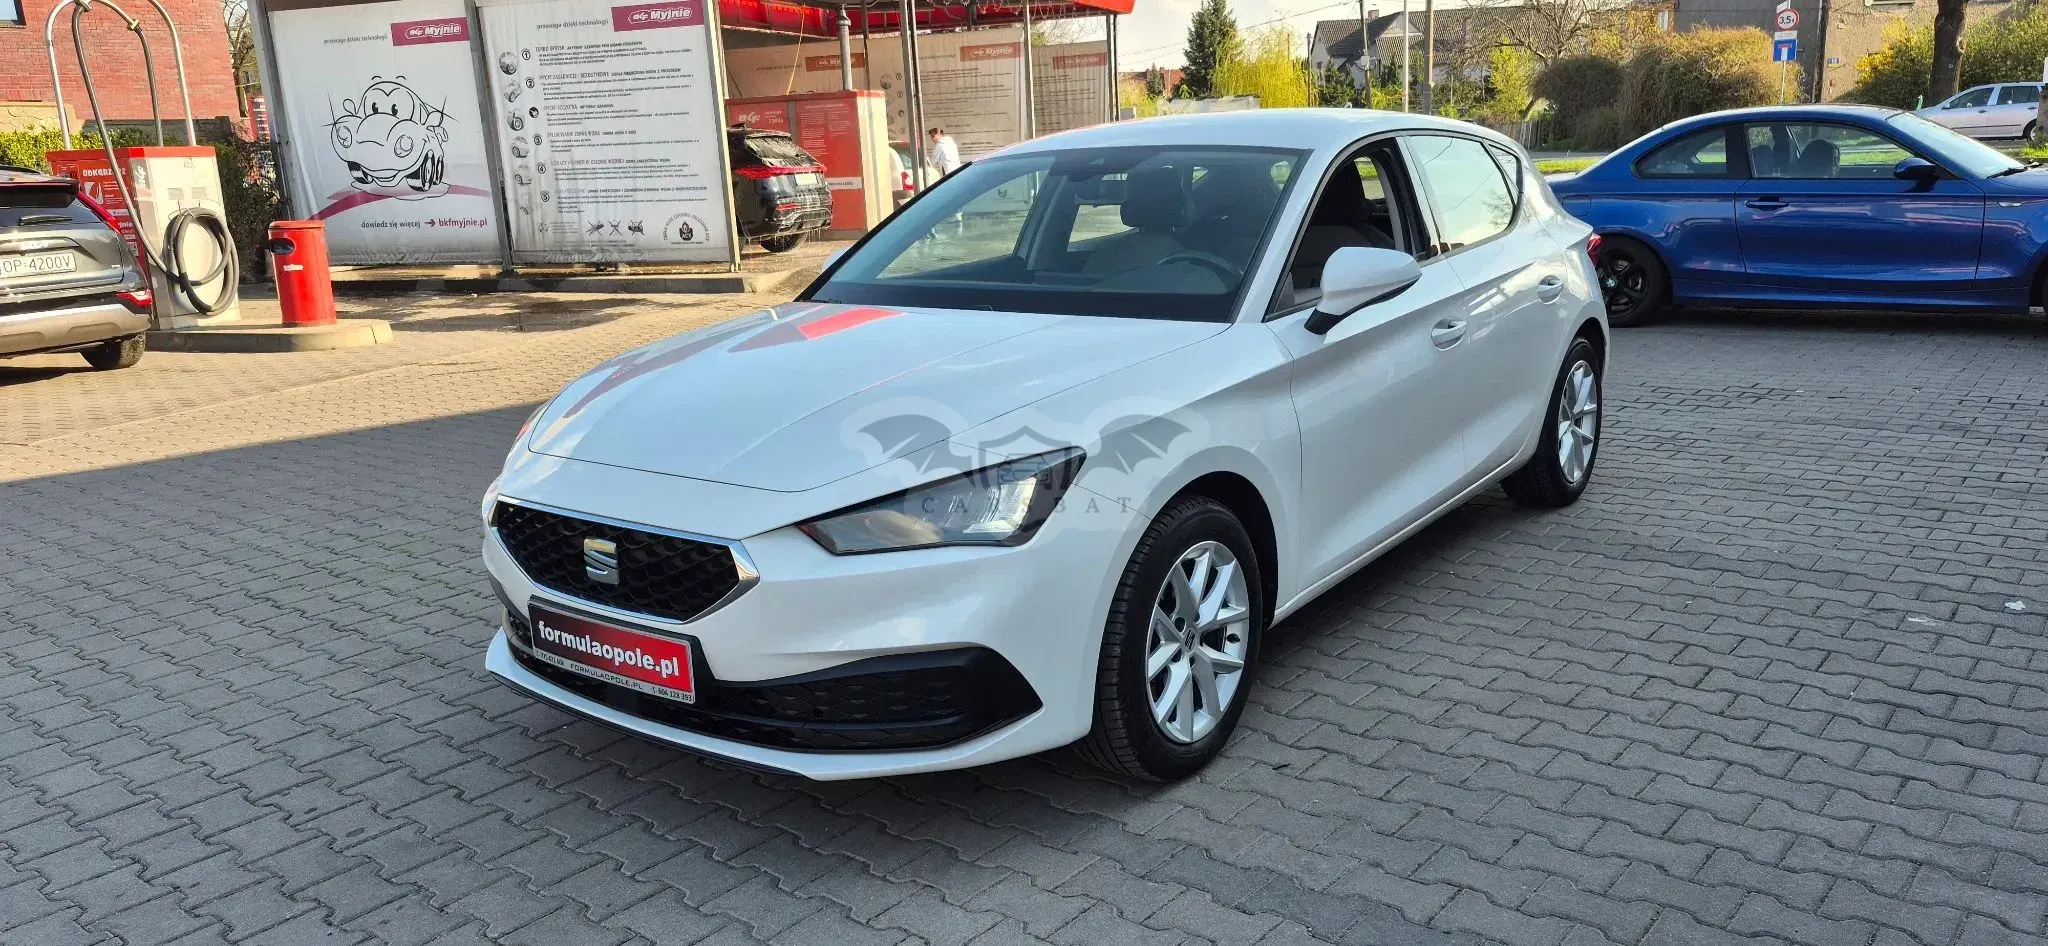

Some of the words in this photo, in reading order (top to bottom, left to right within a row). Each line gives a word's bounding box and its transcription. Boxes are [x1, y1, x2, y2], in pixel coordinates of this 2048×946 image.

[650, 8, 691, 21] Myjnie
[425, 23, 460, 36] Myjnie
[536, 22, 562, 30] przewaga
[579, 18, 609, 27] technologii
[82, 167, 126, 177] ODKURZZ
[361, 220, 388, 228] dowiedz
[389, 220, 398, 229] się
[399, 219, 421, 229] więcej
[438, 217, 488, 229] bkfmyjnie.pl
[3, 259, 22, 273] OP
[28, 255, 70, 271] 4200V
[538, 620, 680, 679] formulaopole.pl
[570, 663, 643, 690] FORMULAOPOLE.PL
[680, 693, 692, 702] 393
